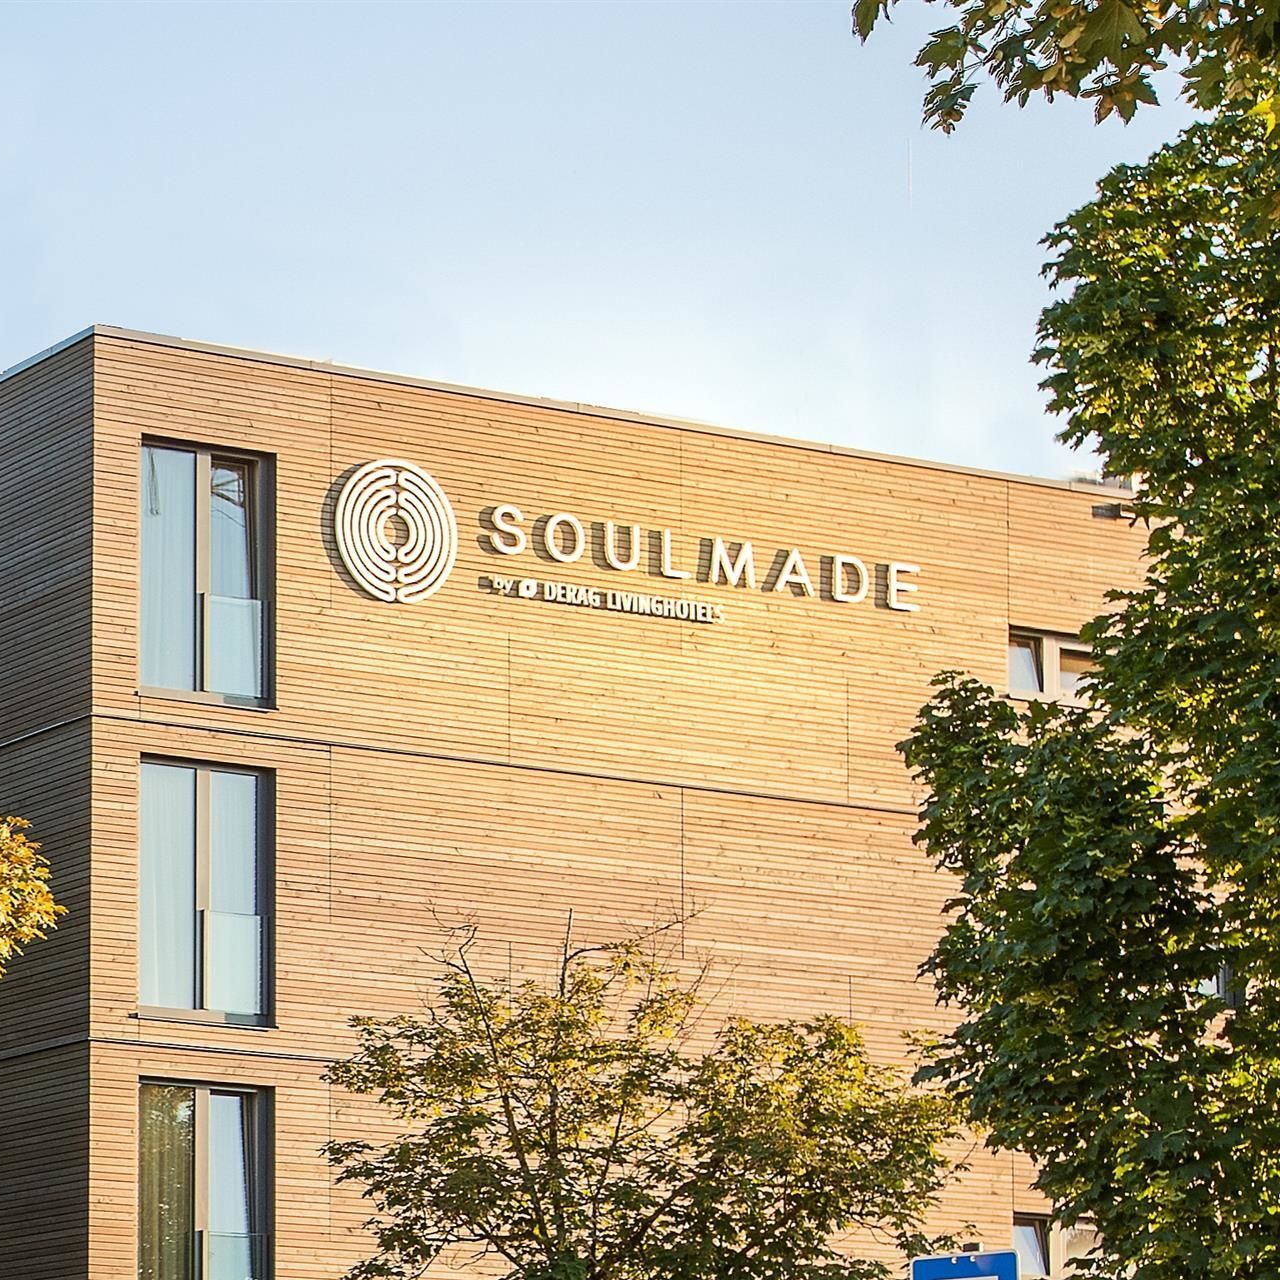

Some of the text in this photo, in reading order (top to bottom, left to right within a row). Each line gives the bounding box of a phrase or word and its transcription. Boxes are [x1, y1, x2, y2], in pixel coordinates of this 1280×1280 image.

[490, 504, 922, 612] SOULMADE
[492, 576, 726, 624] by DERAG LIVINGHOTELS
